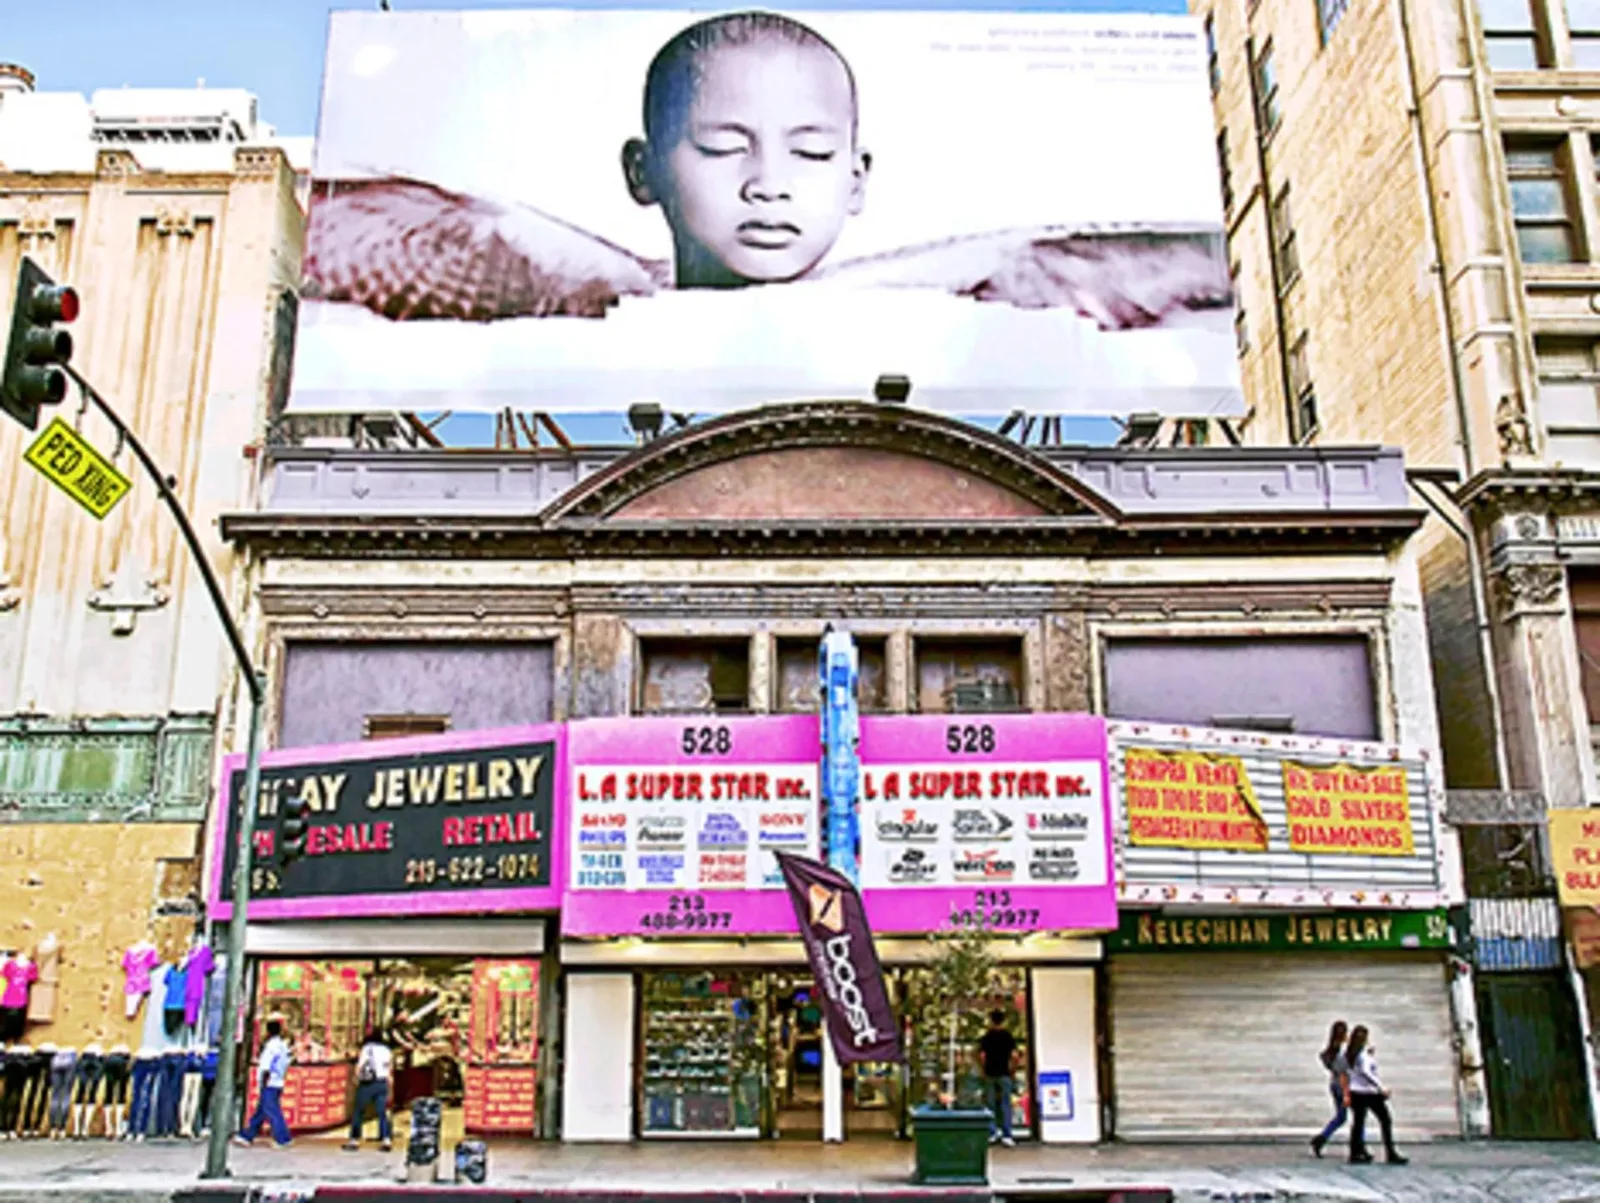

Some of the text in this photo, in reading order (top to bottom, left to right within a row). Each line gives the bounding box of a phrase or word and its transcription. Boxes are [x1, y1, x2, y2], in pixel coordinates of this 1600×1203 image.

[37, 432, 119, 507] PED XING
[682, 726, 732, 754] 528
[947, 724, 996, 753] 528
[365, 756, 546, 808] JEWELRY
[626, 773, 704, 801] SUPER
[710, 773, 770, 801] STAR
[909, 771, 982, 799] SUPER
[990, 771, 1050, 798] STAR
[1288, 795, 1407, 822] GOLD SILVERS
[443, 811, 543, 846] RETAIL
[1291, 822, 1403, 848] DIAMONDS
[669, 896, 705, 911] 213
[975, 890, 1012, 907] 213
[1137, 913, 1270, 945] KELECHIAN
[1285, 913, 1393, 944] JEWELRY
[827, 933, 877, 1047] boost
